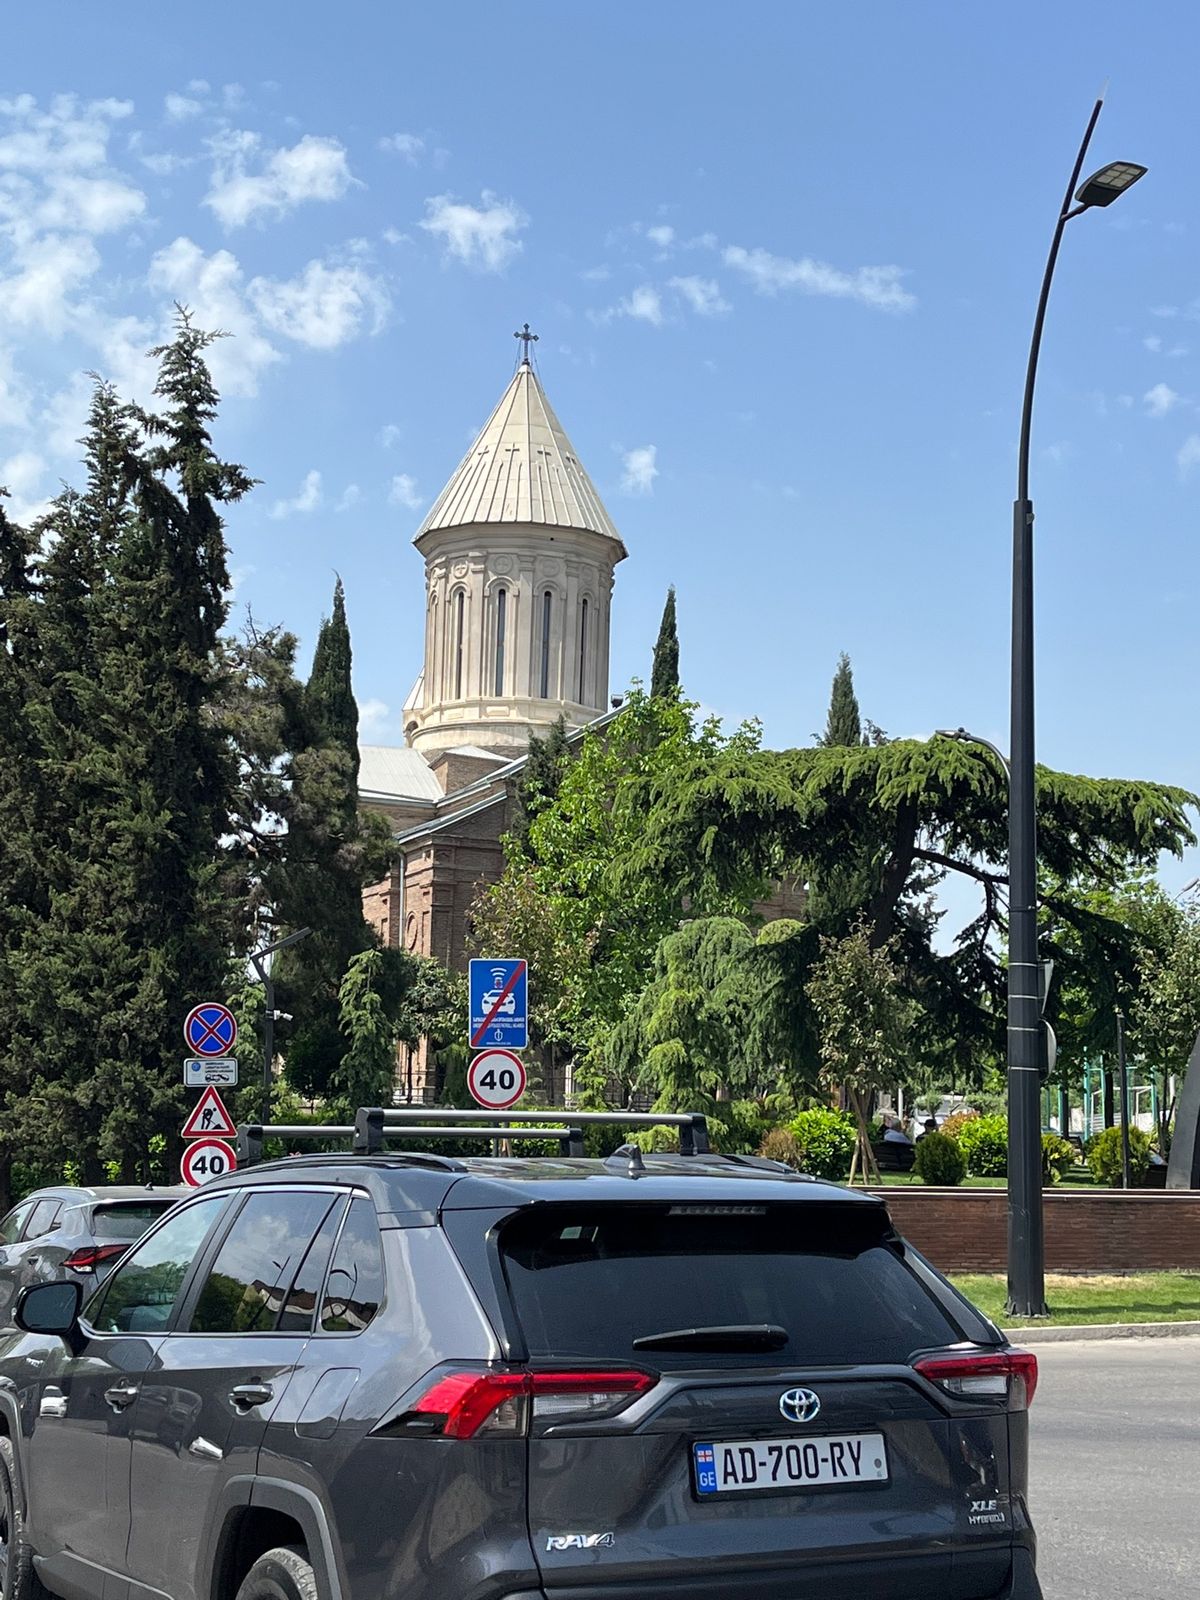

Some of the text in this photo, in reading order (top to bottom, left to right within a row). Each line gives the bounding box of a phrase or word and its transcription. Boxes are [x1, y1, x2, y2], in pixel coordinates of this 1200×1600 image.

[479, 1069, 515, 1090] 40
[192, 1156, 224, 1174] 40
[723, 1441, 862, 1485] AD-700-RY
[699, 1471, 716, 1487] GE
[970, 1500, 997, 1512] XLE
[545, 1531, 615, 1551] RAV4
